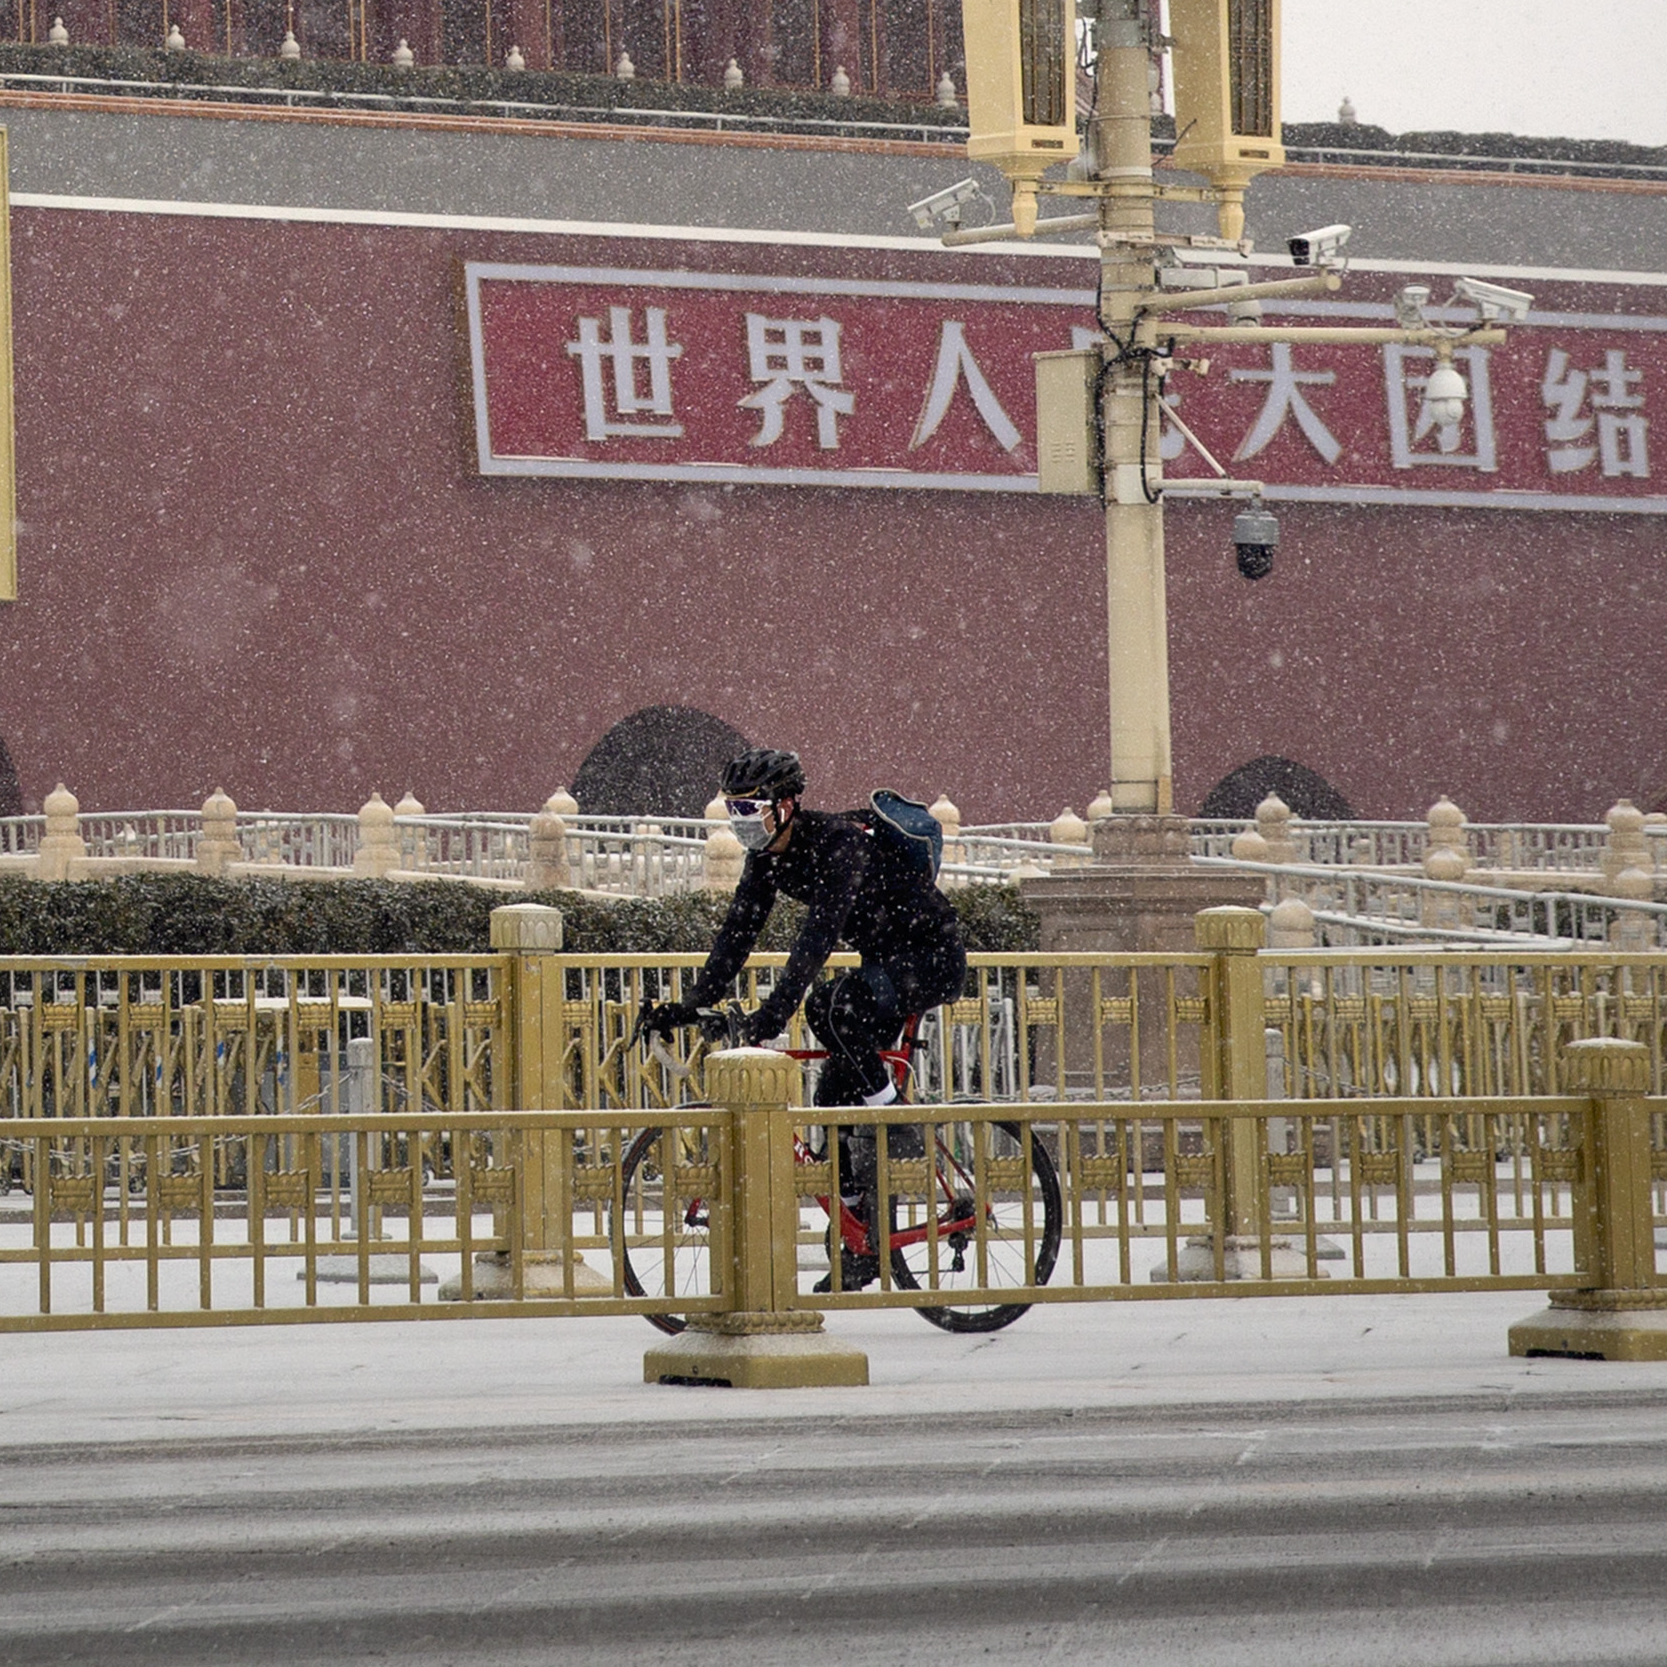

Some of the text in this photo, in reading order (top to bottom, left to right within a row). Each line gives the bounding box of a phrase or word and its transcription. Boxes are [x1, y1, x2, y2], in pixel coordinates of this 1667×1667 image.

[566, 307, 1650, 478] 世界人大团结
